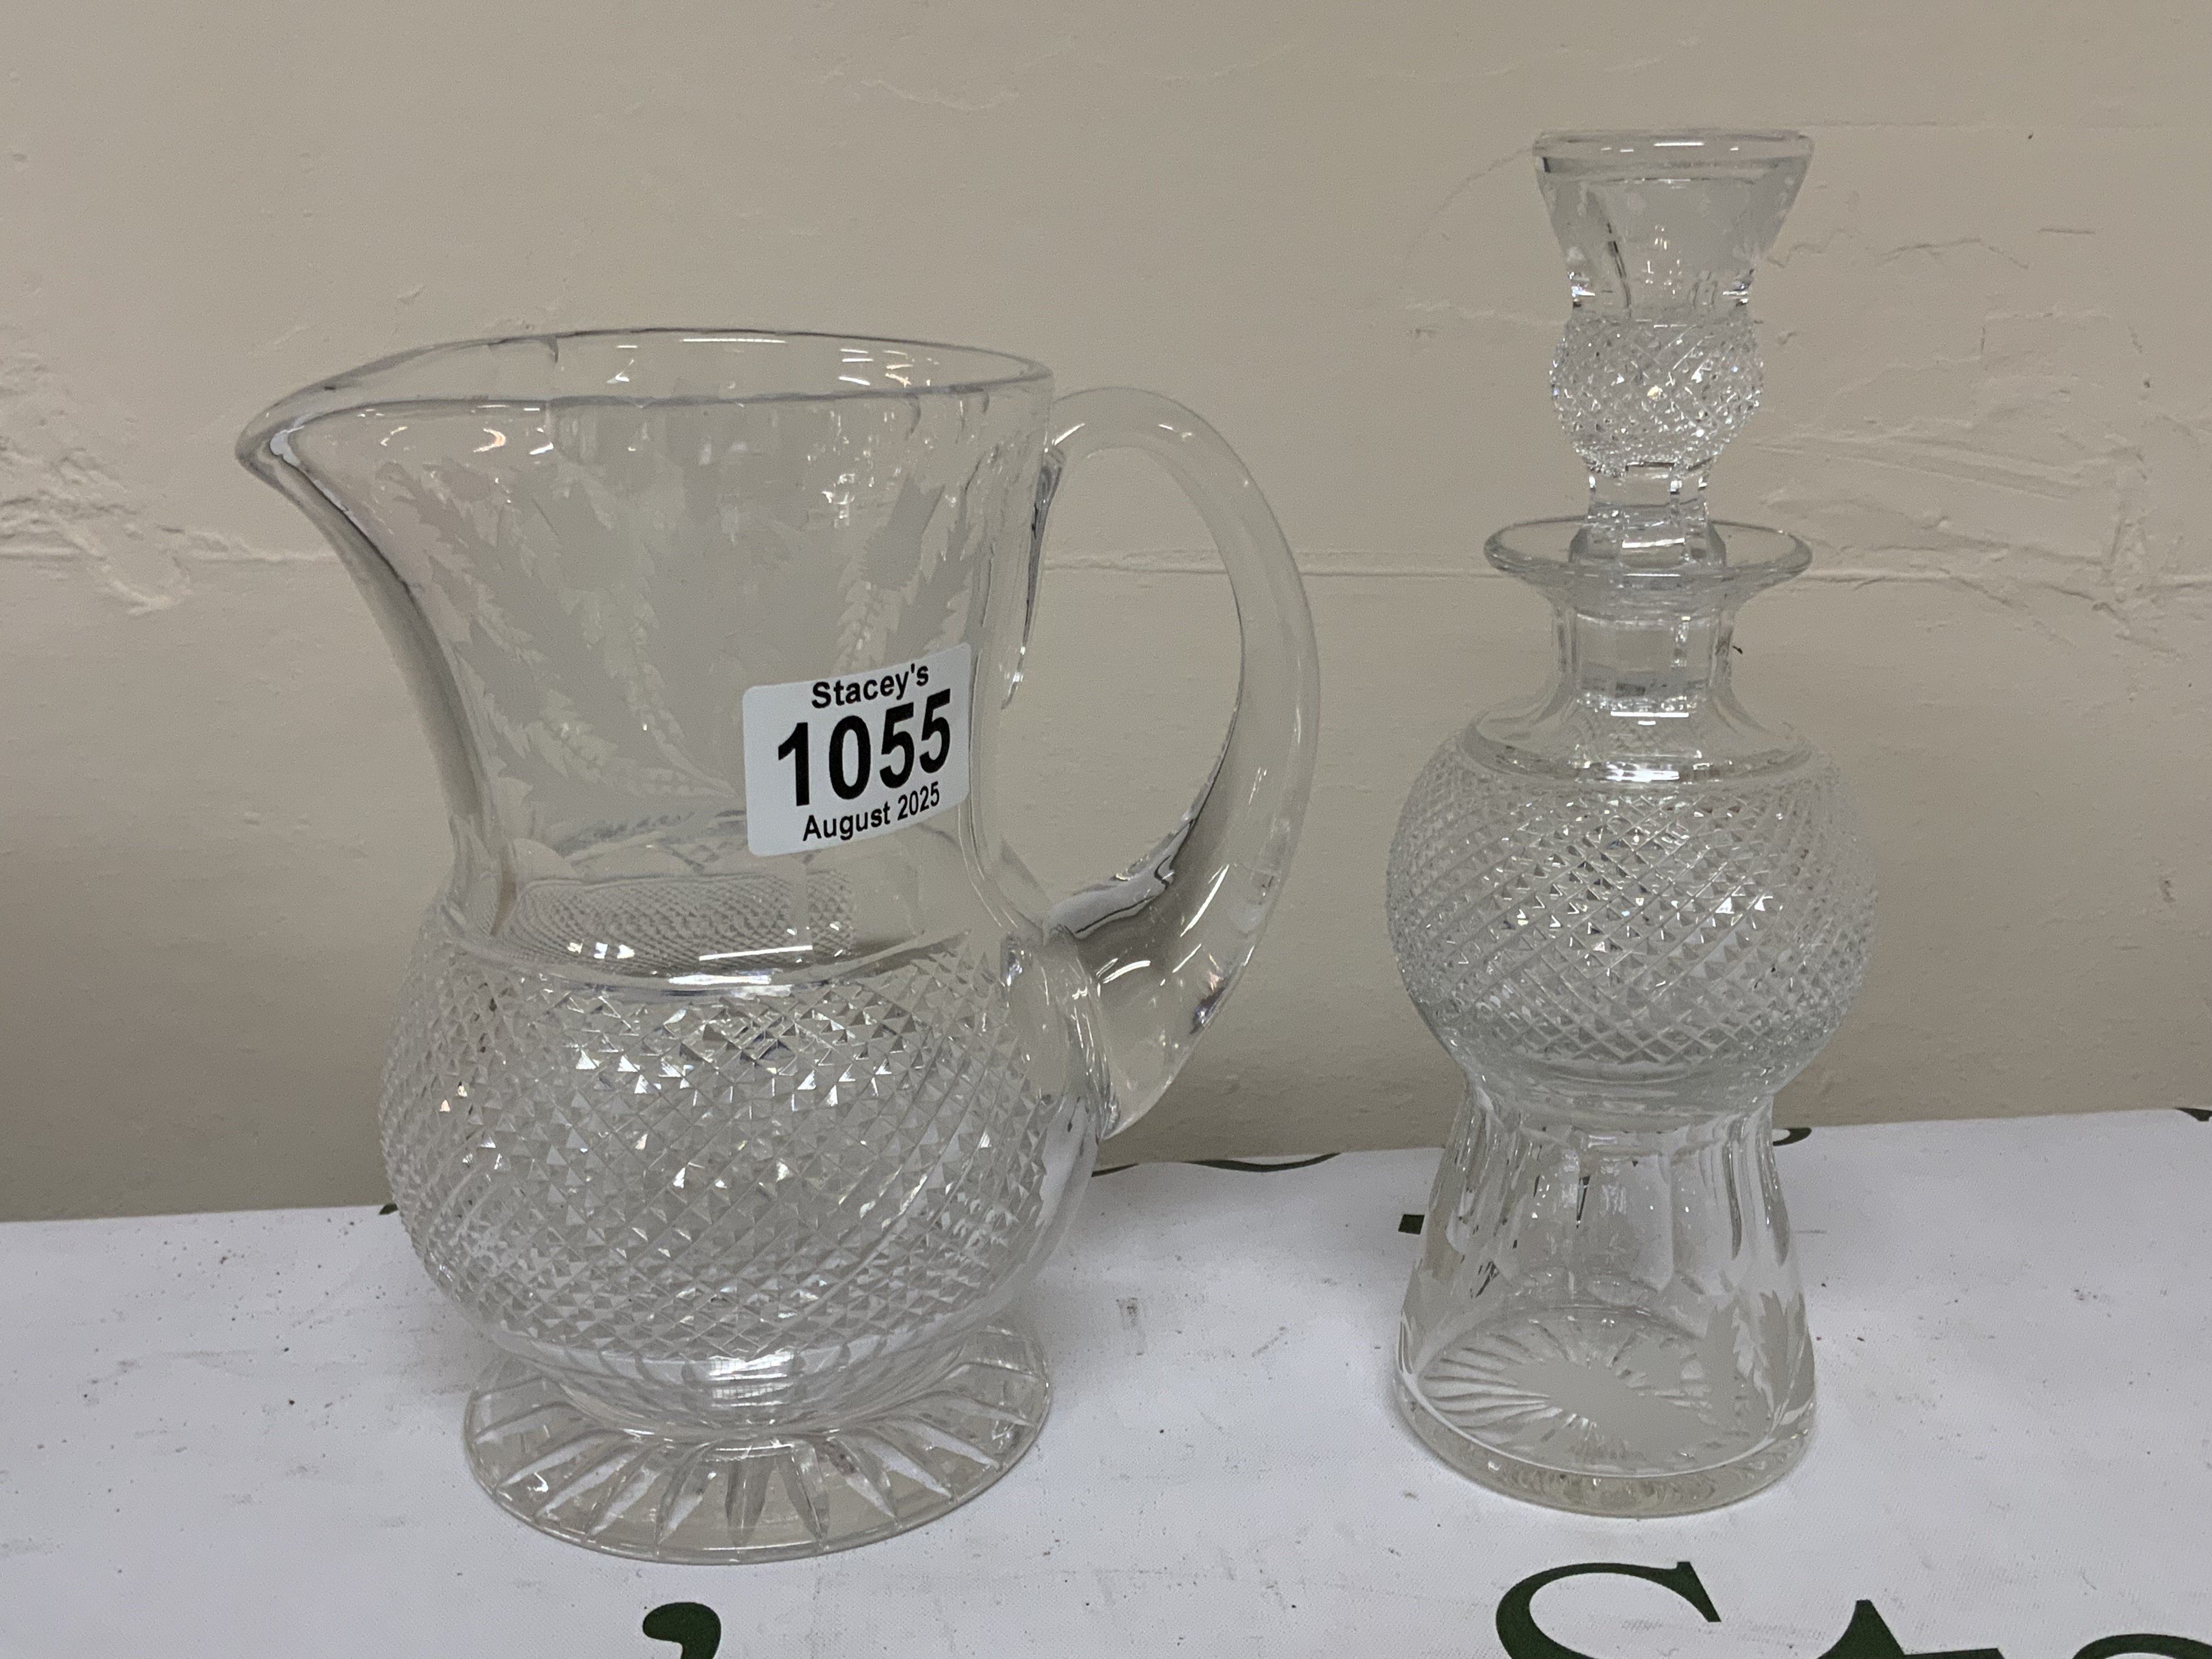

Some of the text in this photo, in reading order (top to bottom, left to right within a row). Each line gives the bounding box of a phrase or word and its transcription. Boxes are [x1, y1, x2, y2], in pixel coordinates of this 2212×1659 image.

[811, 663, 929, 709] Stacey's
[778, 689, 951, 806] 1055
[803, 781, 940, 842] August 2025
